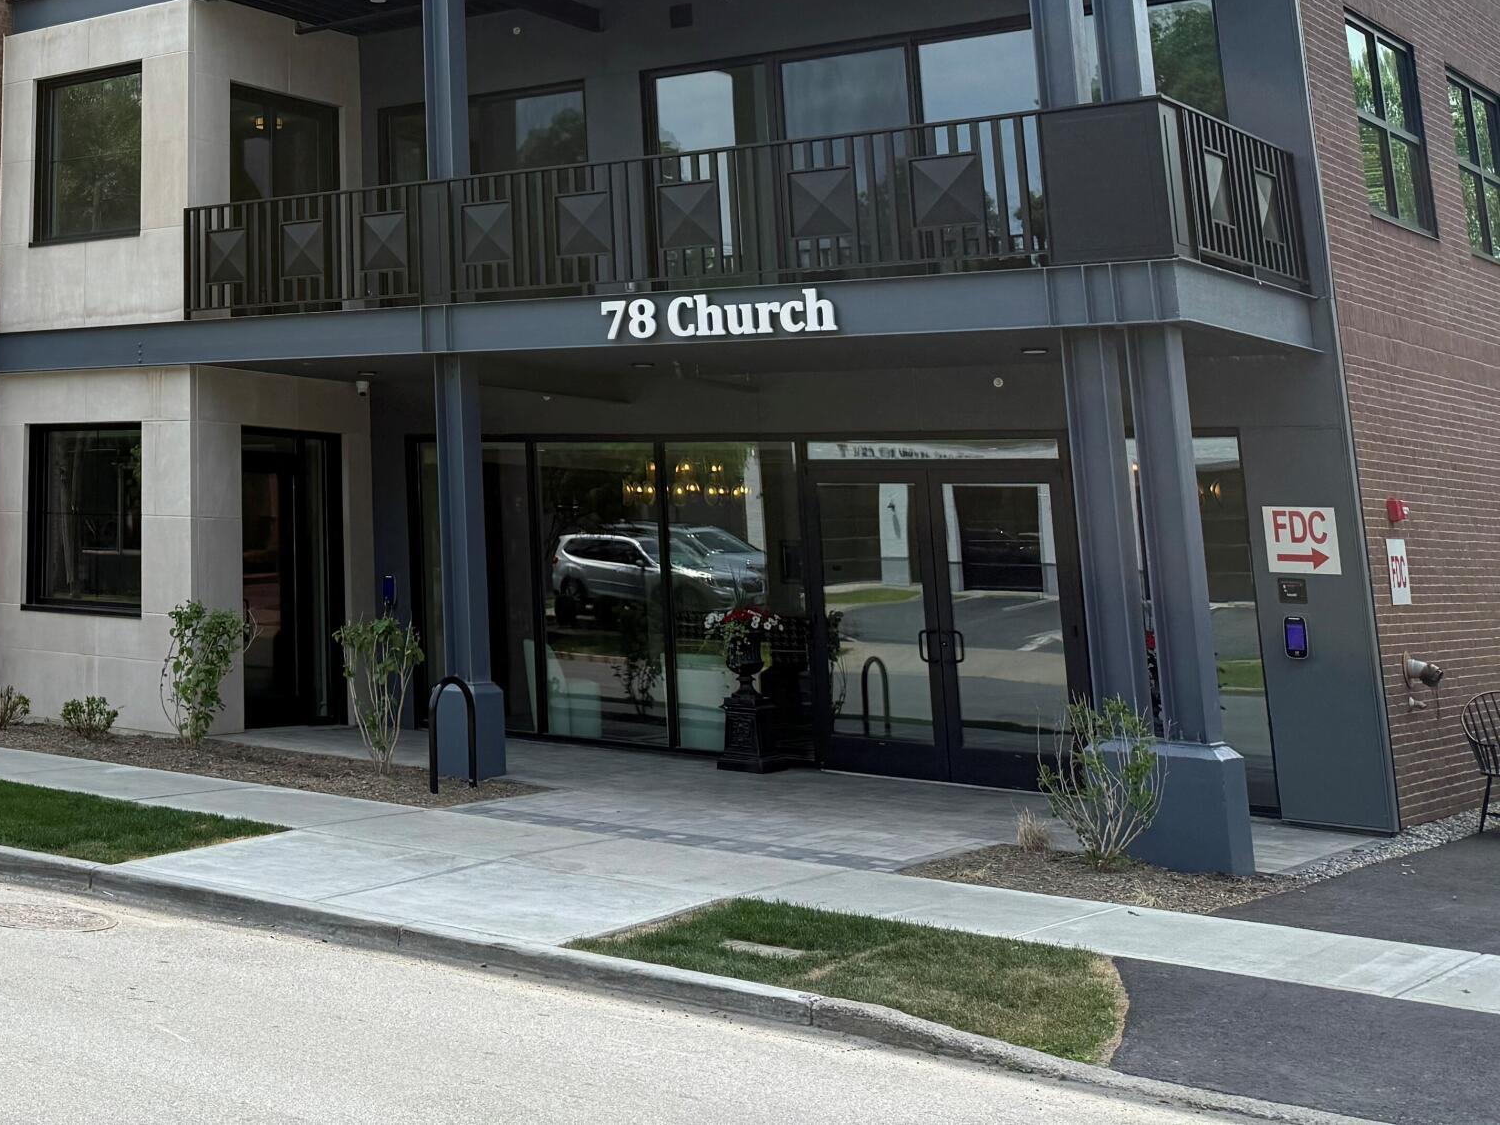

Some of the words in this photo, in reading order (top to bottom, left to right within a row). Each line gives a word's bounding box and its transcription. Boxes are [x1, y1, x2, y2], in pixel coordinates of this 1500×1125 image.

[601, 299, 656, 339] 78
[667, 288, 838, 337] Church
[1272, 510, 1327, 544] FDC
[1390, 556, 1407, 589] FDC
